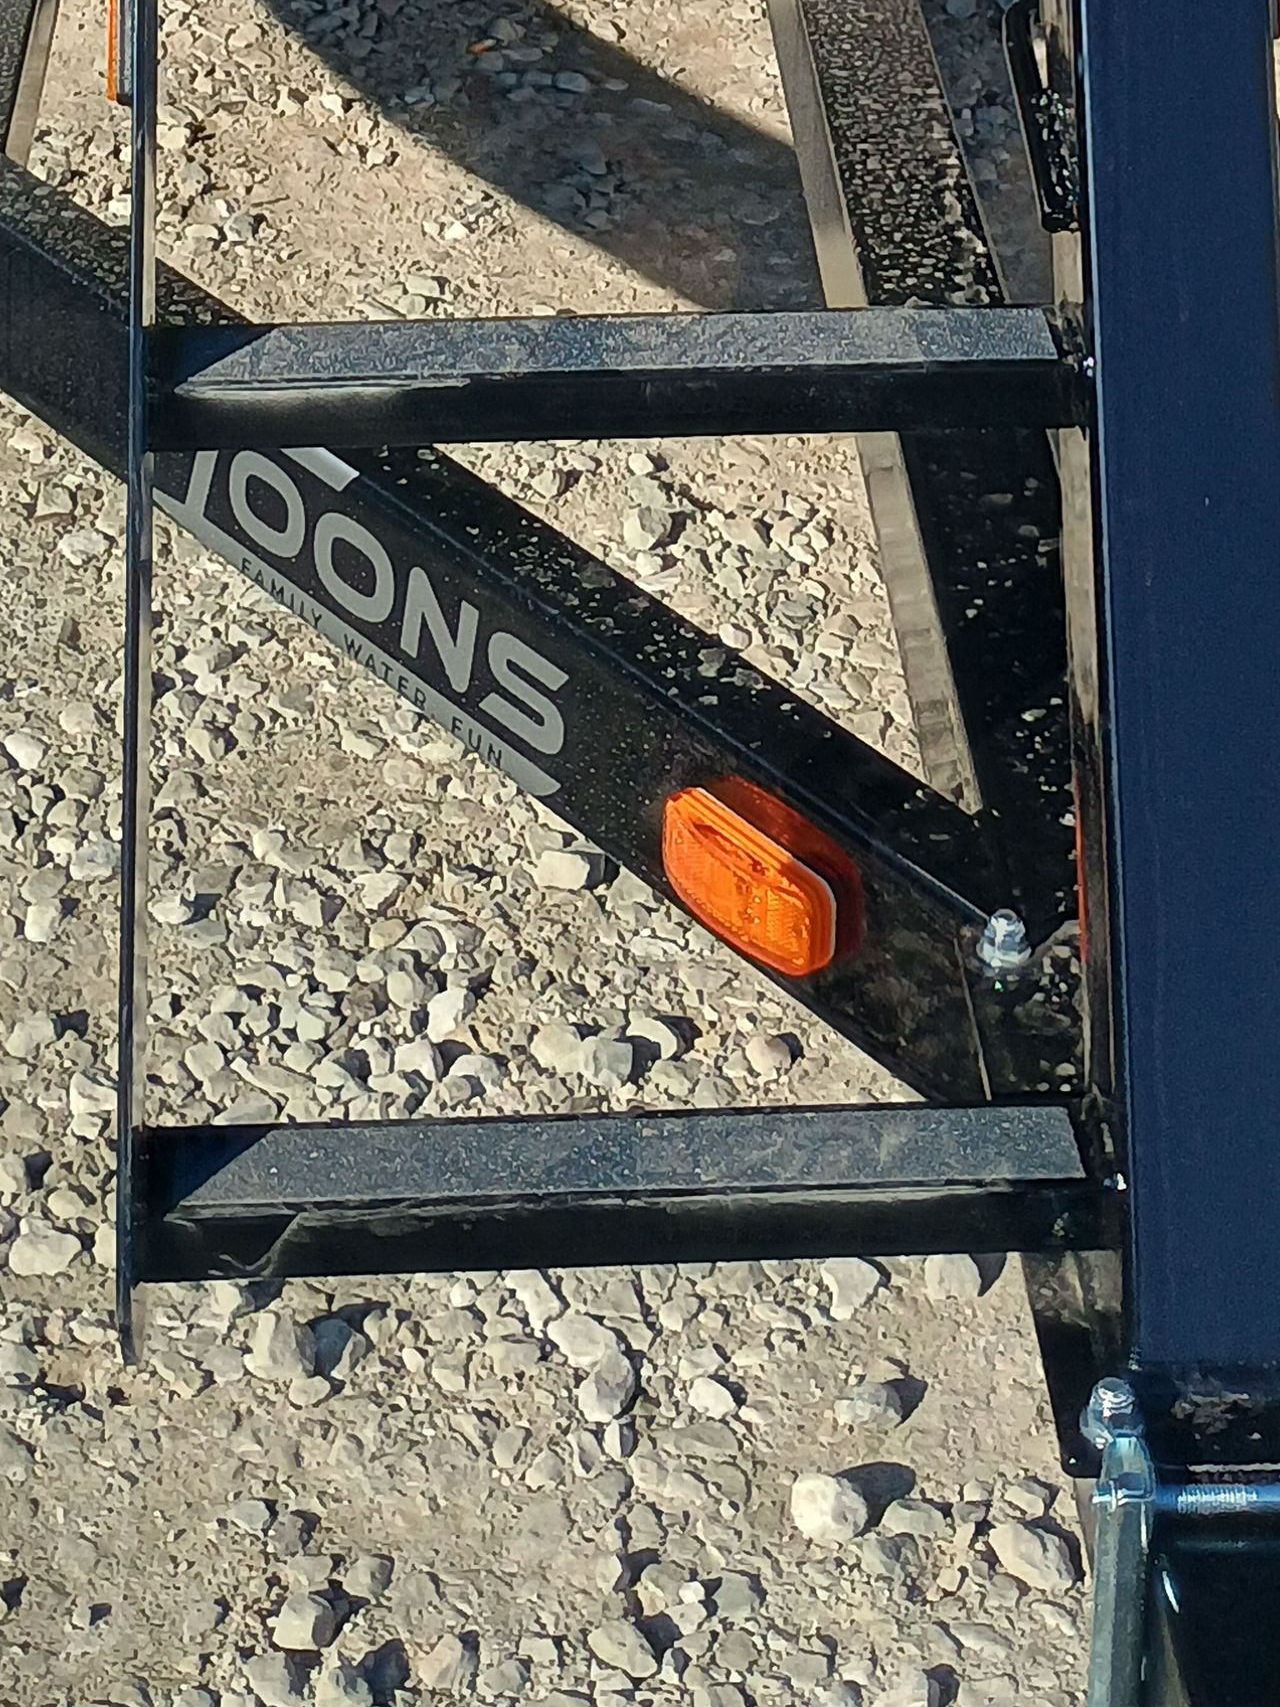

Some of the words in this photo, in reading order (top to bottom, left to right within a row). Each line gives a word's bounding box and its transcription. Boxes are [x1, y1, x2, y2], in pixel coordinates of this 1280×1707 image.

[240, 557, 324, 627] FAMILY
[342, 632, 427, 713] WATER
[450, 715, 504, 767] FUN
